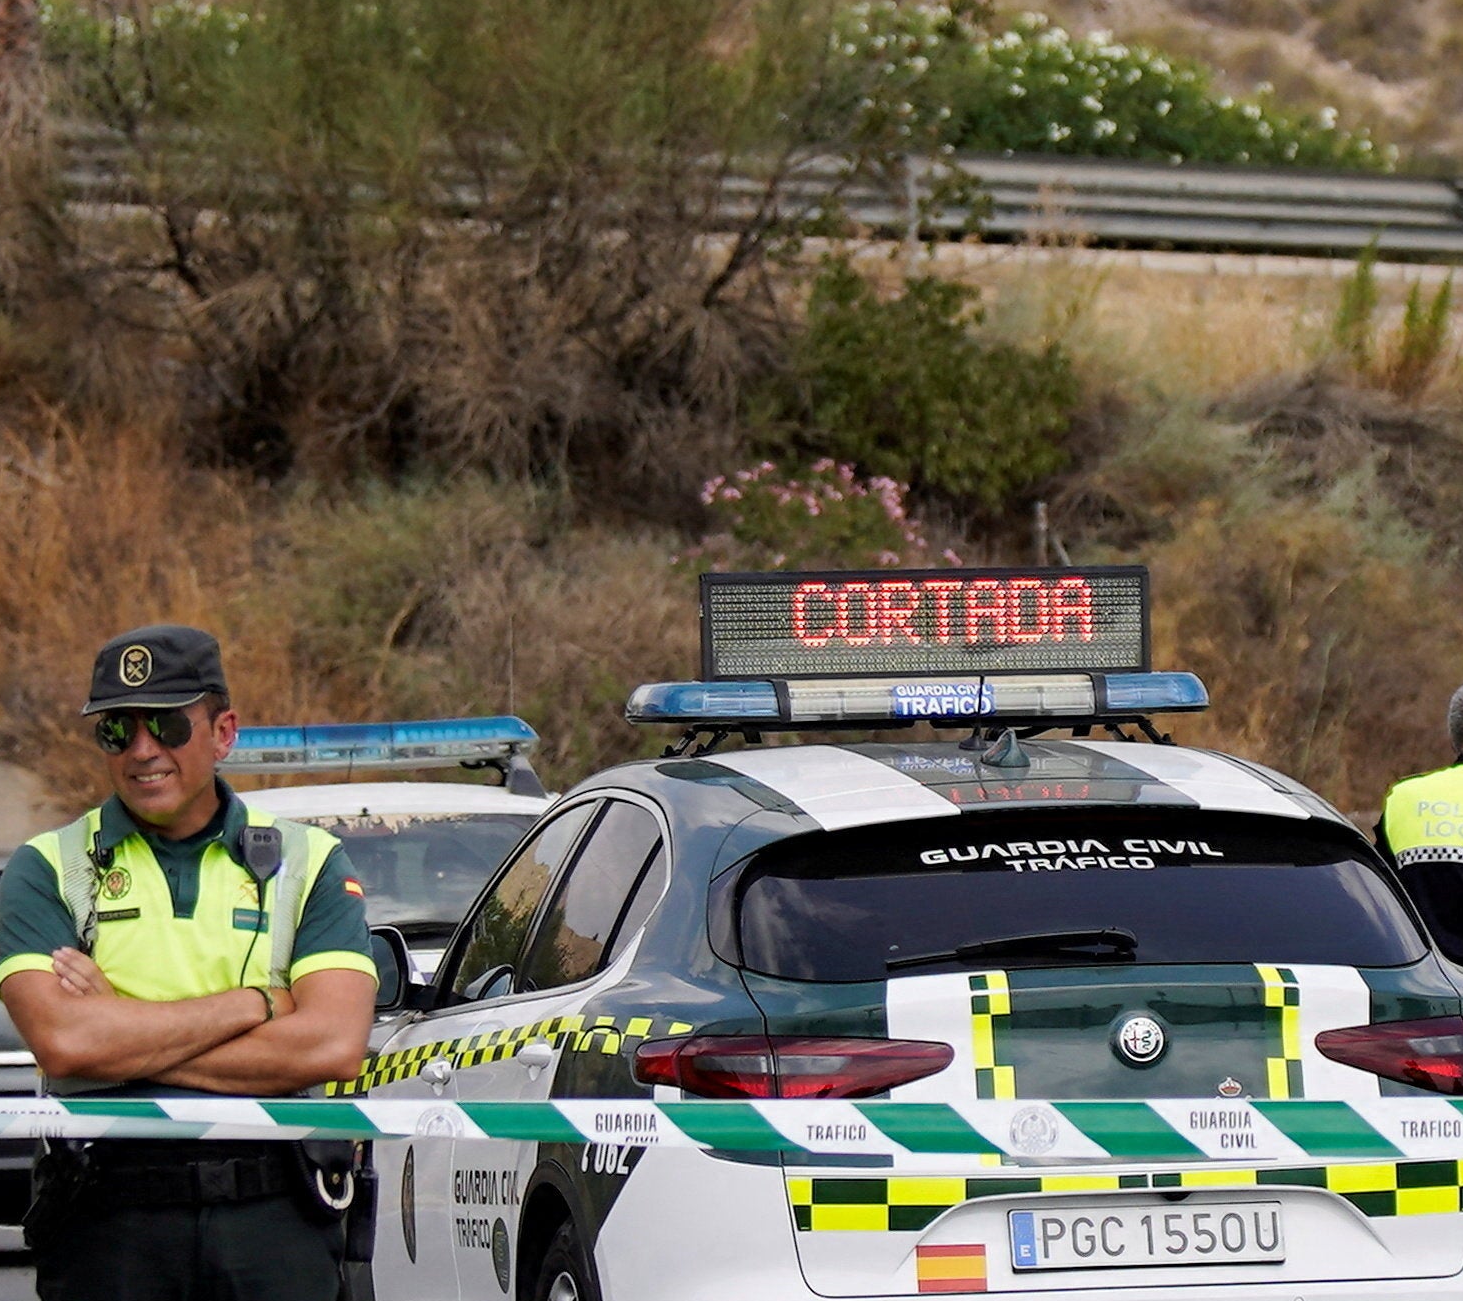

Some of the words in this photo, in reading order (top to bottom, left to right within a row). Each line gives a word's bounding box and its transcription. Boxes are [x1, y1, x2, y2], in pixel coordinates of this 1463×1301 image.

[792, 577, 1095, 648] CORTADA
[896, 685, 956, 697] GUARDIA
[897, 695, 992, 716] TRAFICO
[918, 838, 1111, 866] GUARDIA
[1122, 838, 1225, 858] CIVIL
[595, 1112, 658, 1133] GUARDIA
[1189, 1110, 1253, 1130] GUARDIA
[1400, 1118, 1462, 1139] TRAFICO
[807, 1122, 867, 1142] TRAFICO
[1219, 1131, 1258, 1149] CIVIL
[454, 1169, 499, 1205] GUARDIA
[1041, 1216, 1126, 1259] PGC
